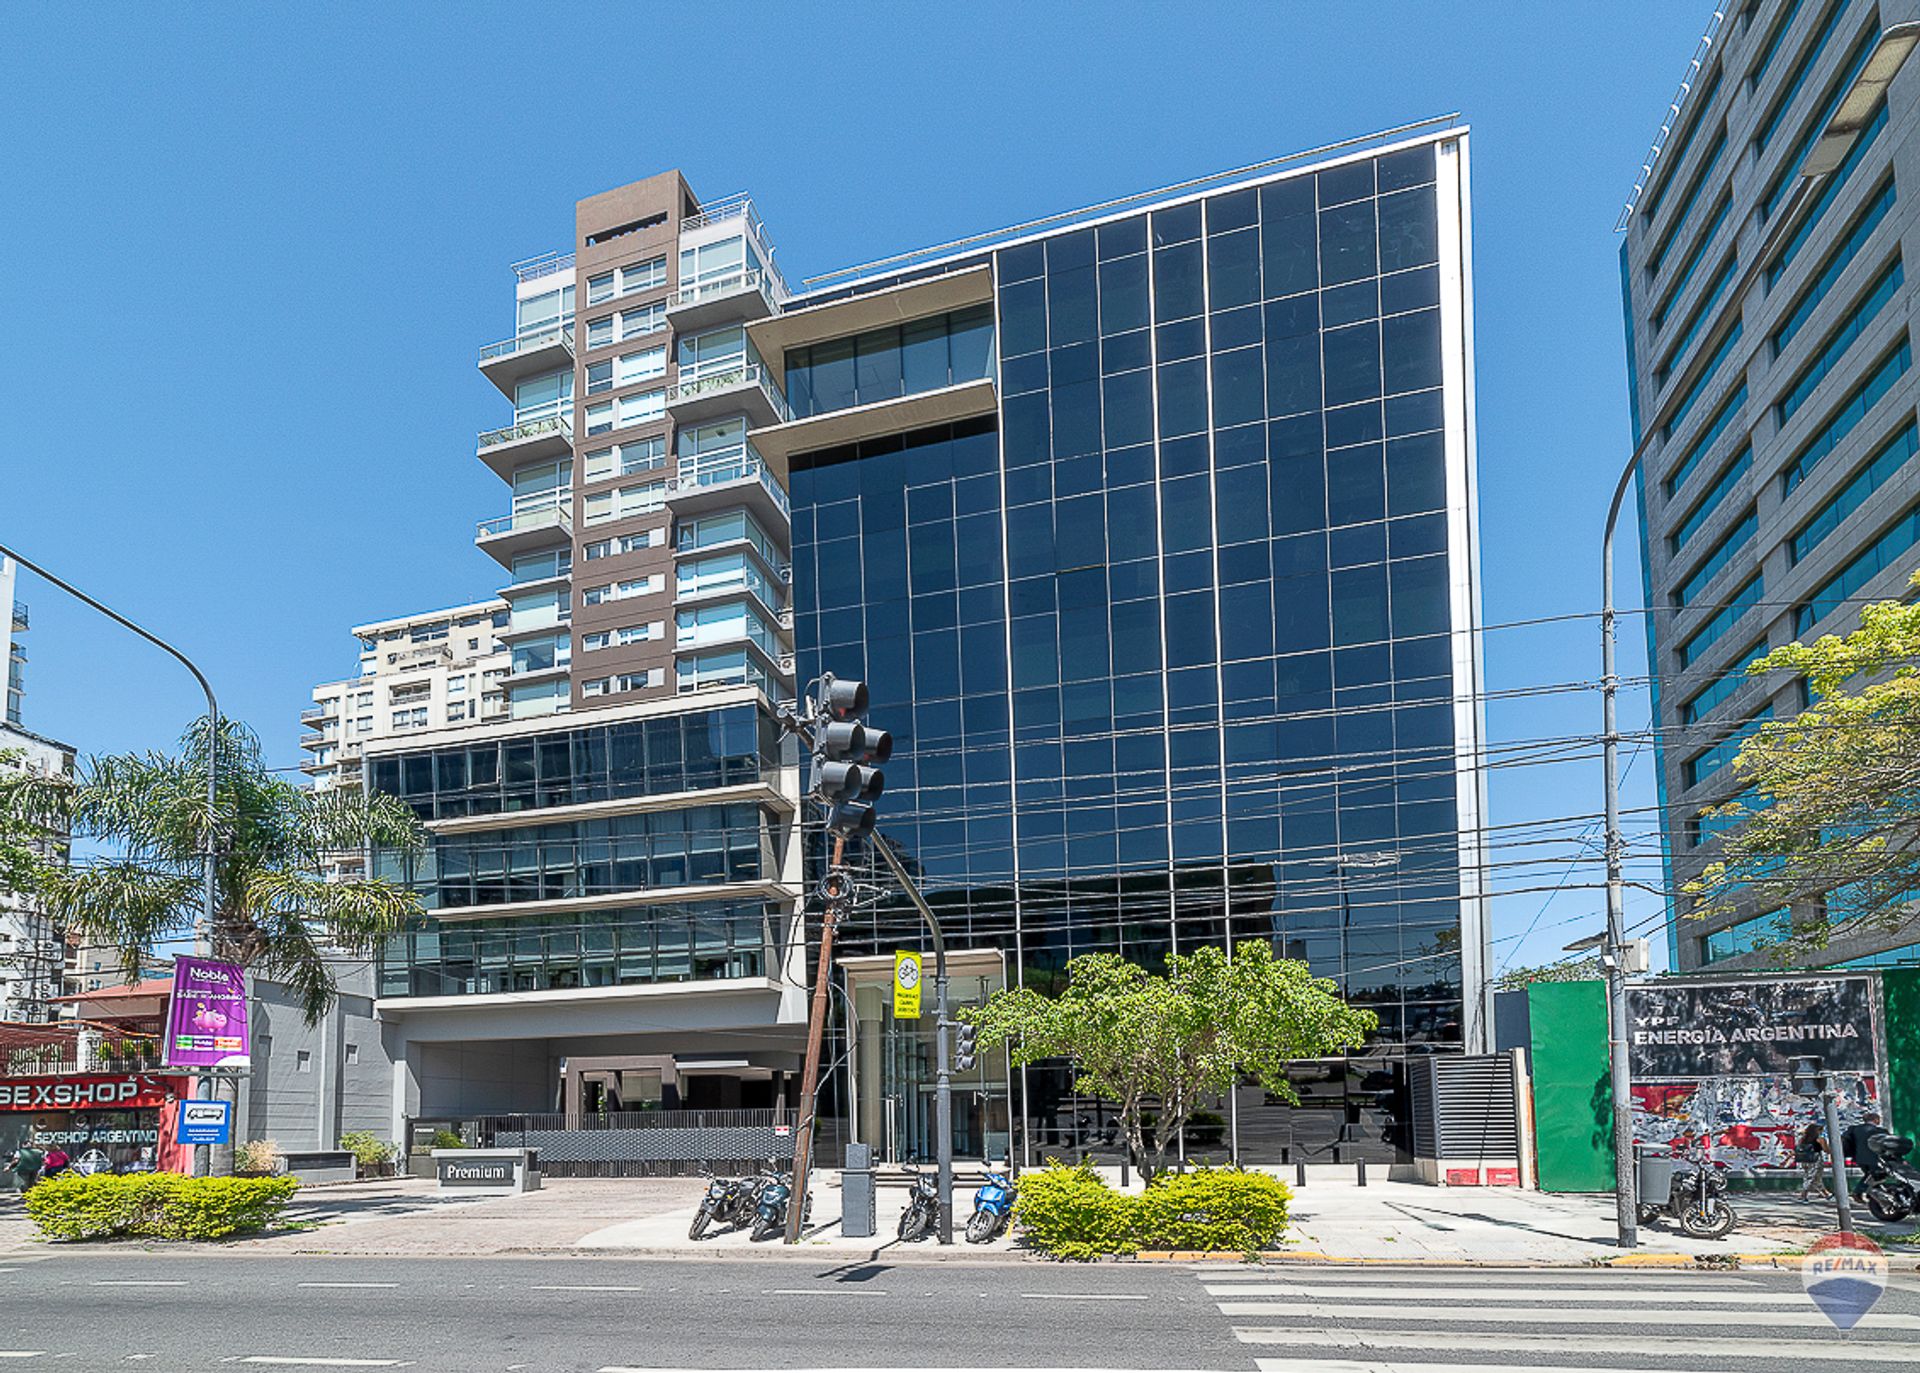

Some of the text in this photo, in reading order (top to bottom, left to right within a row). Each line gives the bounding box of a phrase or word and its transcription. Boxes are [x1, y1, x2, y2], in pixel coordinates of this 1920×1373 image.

[190, 967, 229, 982] Noble
[1635, 1016, 1679, 1027] YPF
[1634, 1023, 1859, 1046] ENERGÍA ARGENTINA
[0, 1083, 138, 1104] SEXSHOP
[34, 1130, 158, 1145] SEXSHOP ARGENTINO
[447, 1165, 505, 1179] Premium
